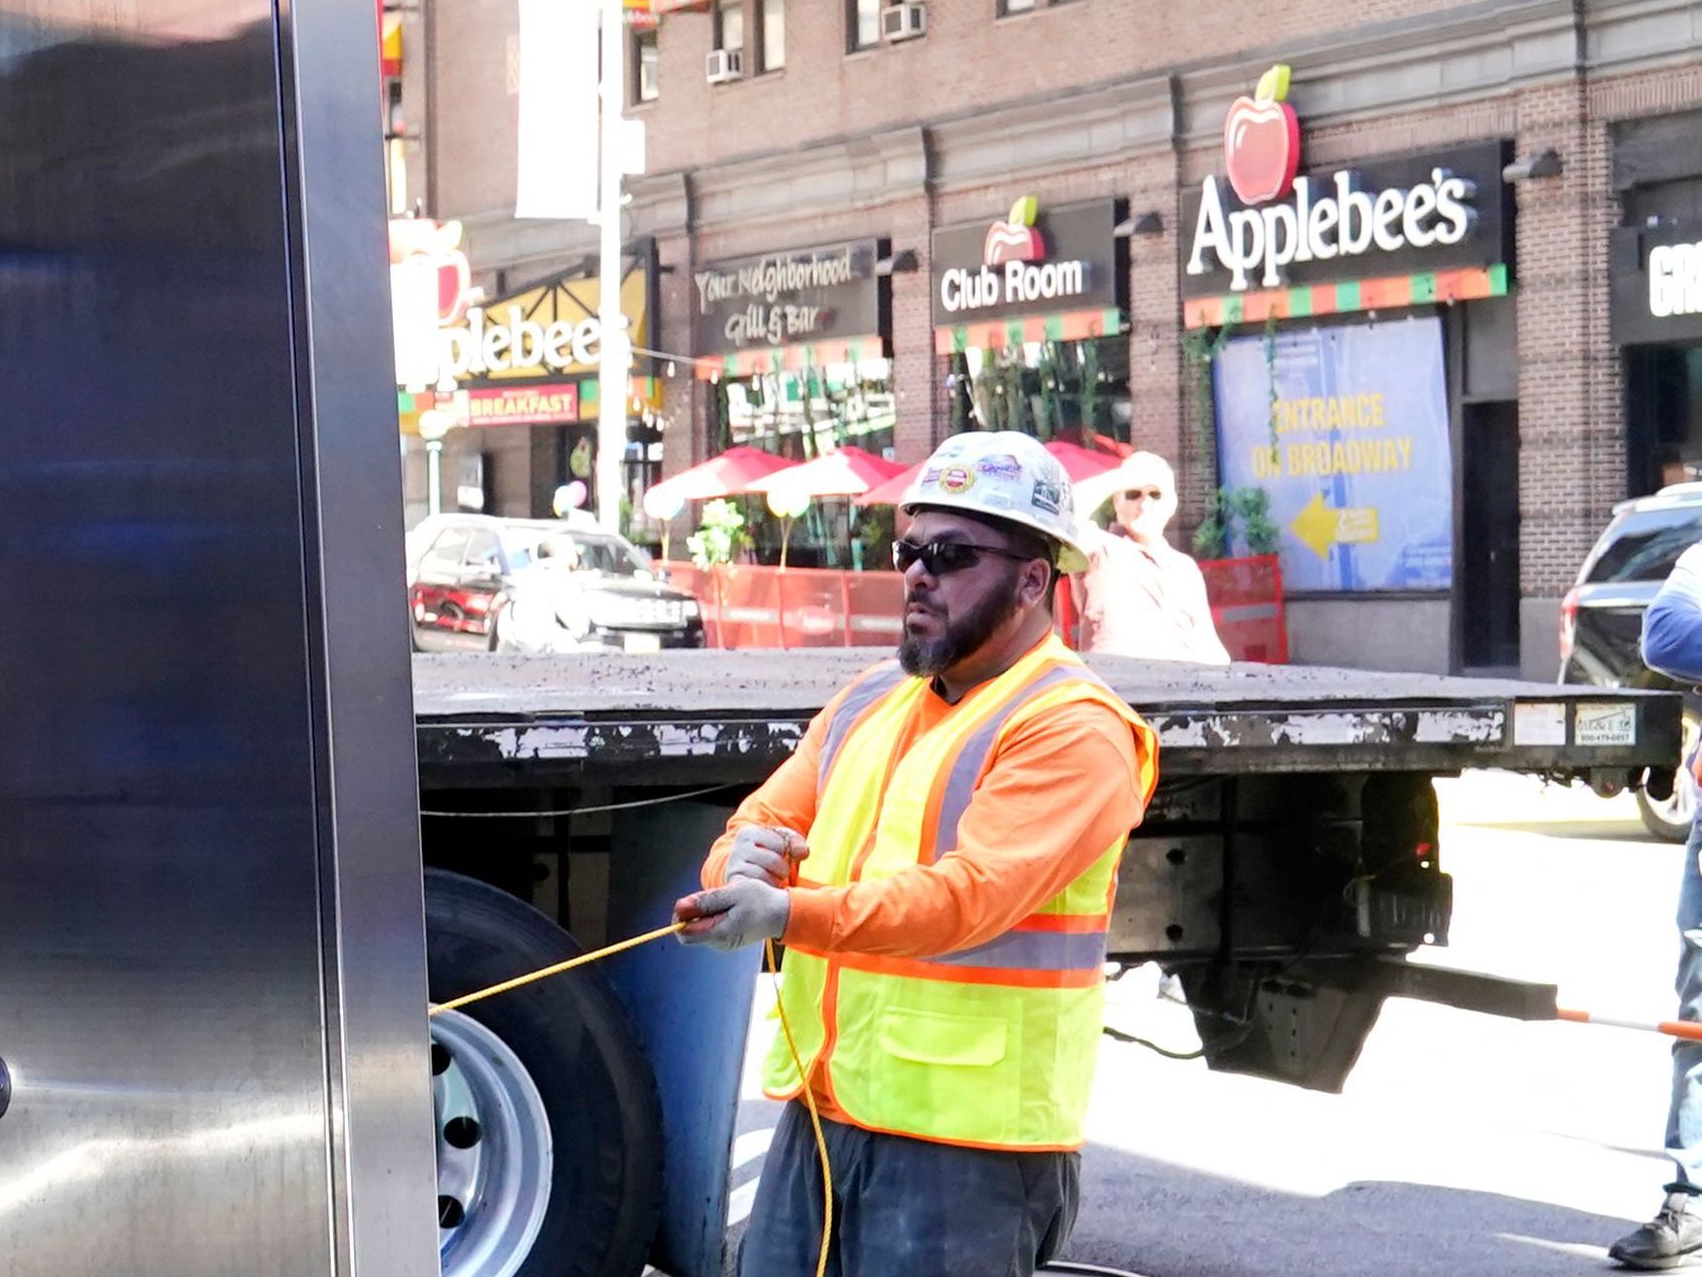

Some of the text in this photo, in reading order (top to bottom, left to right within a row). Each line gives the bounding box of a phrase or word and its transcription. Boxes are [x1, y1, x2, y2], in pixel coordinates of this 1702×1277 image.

[1187, 167, 1468, 291] Applebee's
[695, 247, 852, 315] Your Neighborhood
[941, 260, 1083, 312] Club Room
[725, 302, 766, 347] Grill
[785, 304, 820, 335] Bar
[469, 393, 573, 416] BREAKFAST
[1272, 393, 1386, 434] ENTRANCE
[1252, 437, 1414, 479] ON BROADWAY
